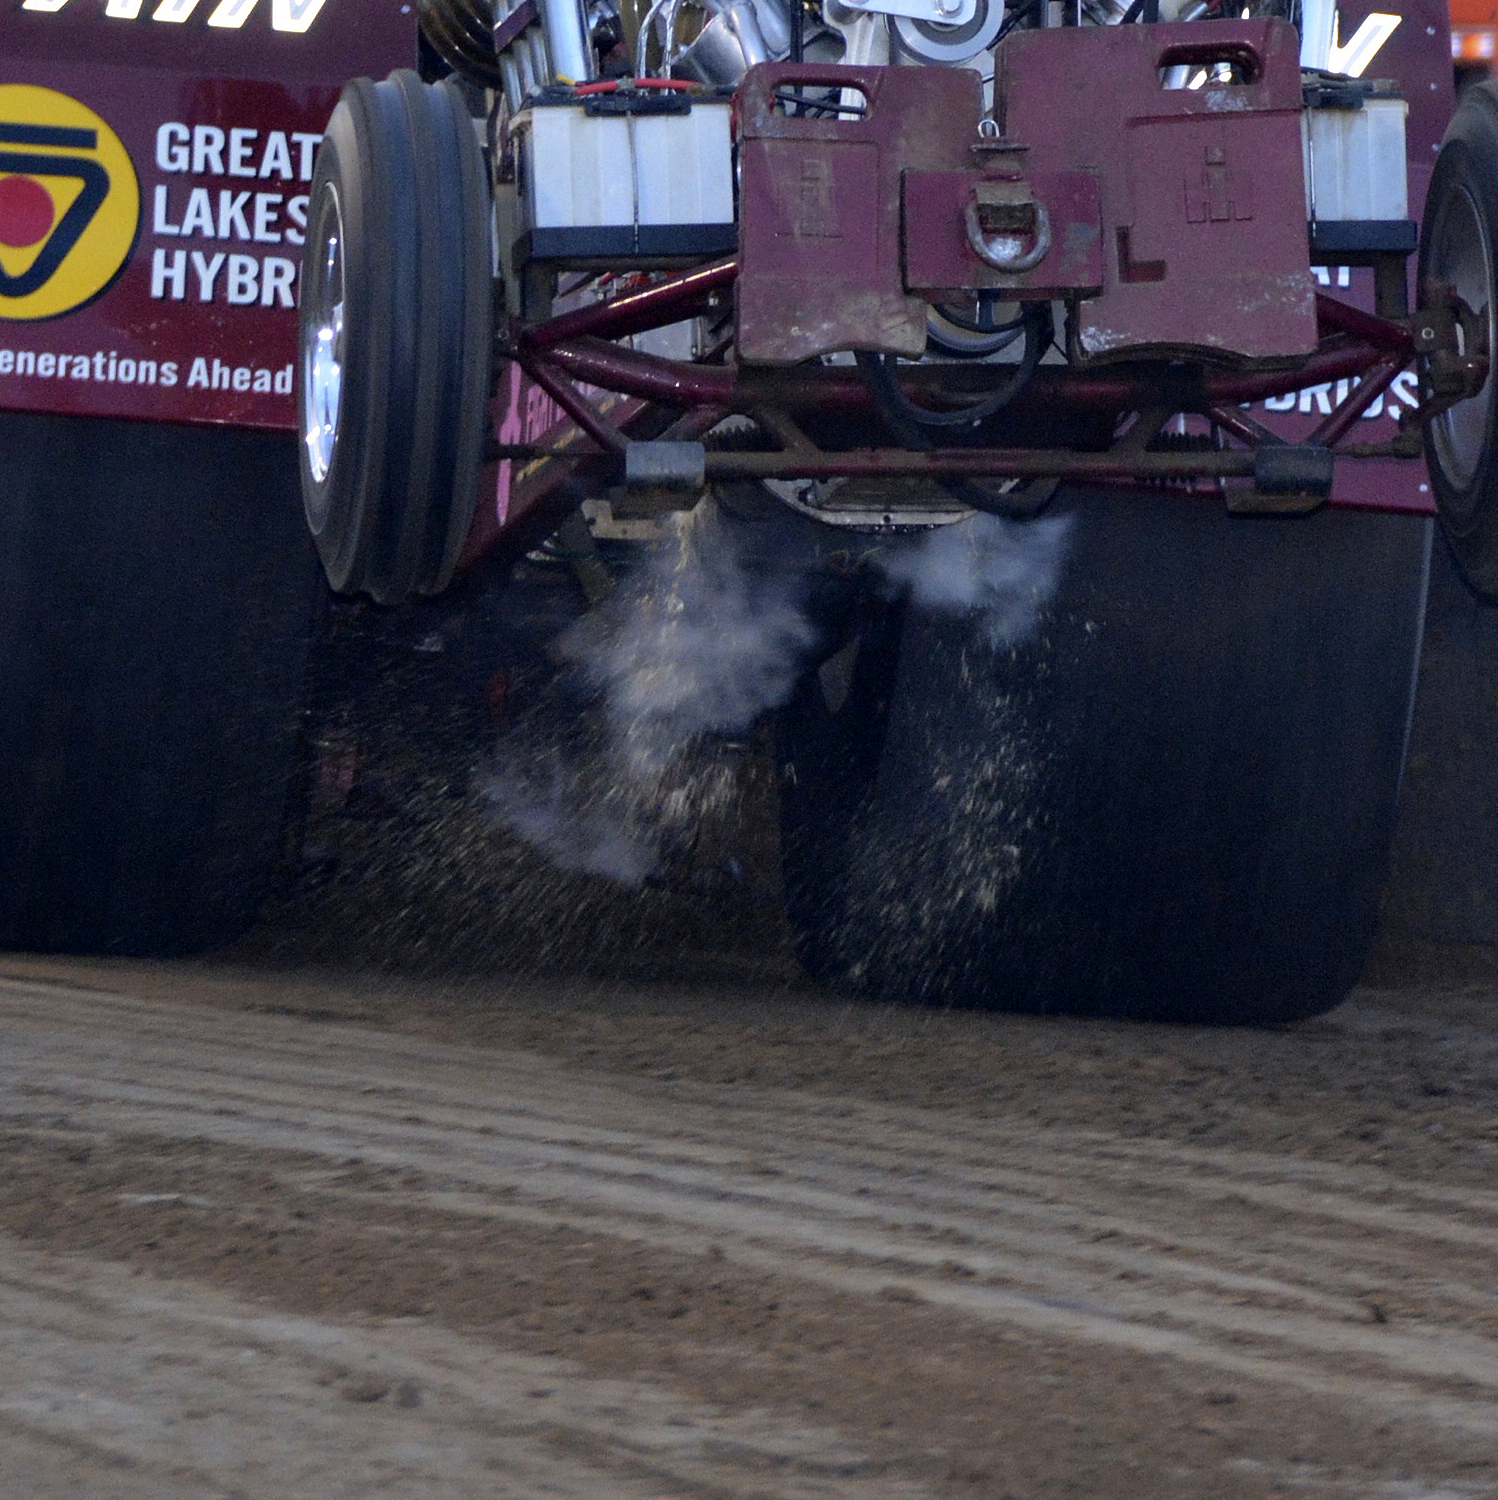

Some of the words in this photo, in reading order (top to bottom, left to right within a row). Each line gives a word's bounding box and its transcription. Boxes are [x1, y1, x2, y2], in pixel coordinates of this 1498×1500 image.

[156, 121, 323, 182] GREAT
[153, 184, 310, 246] LAKES
[151, 248, 303, 309] HYBR
[186, 356, 295, 396] Ahead
